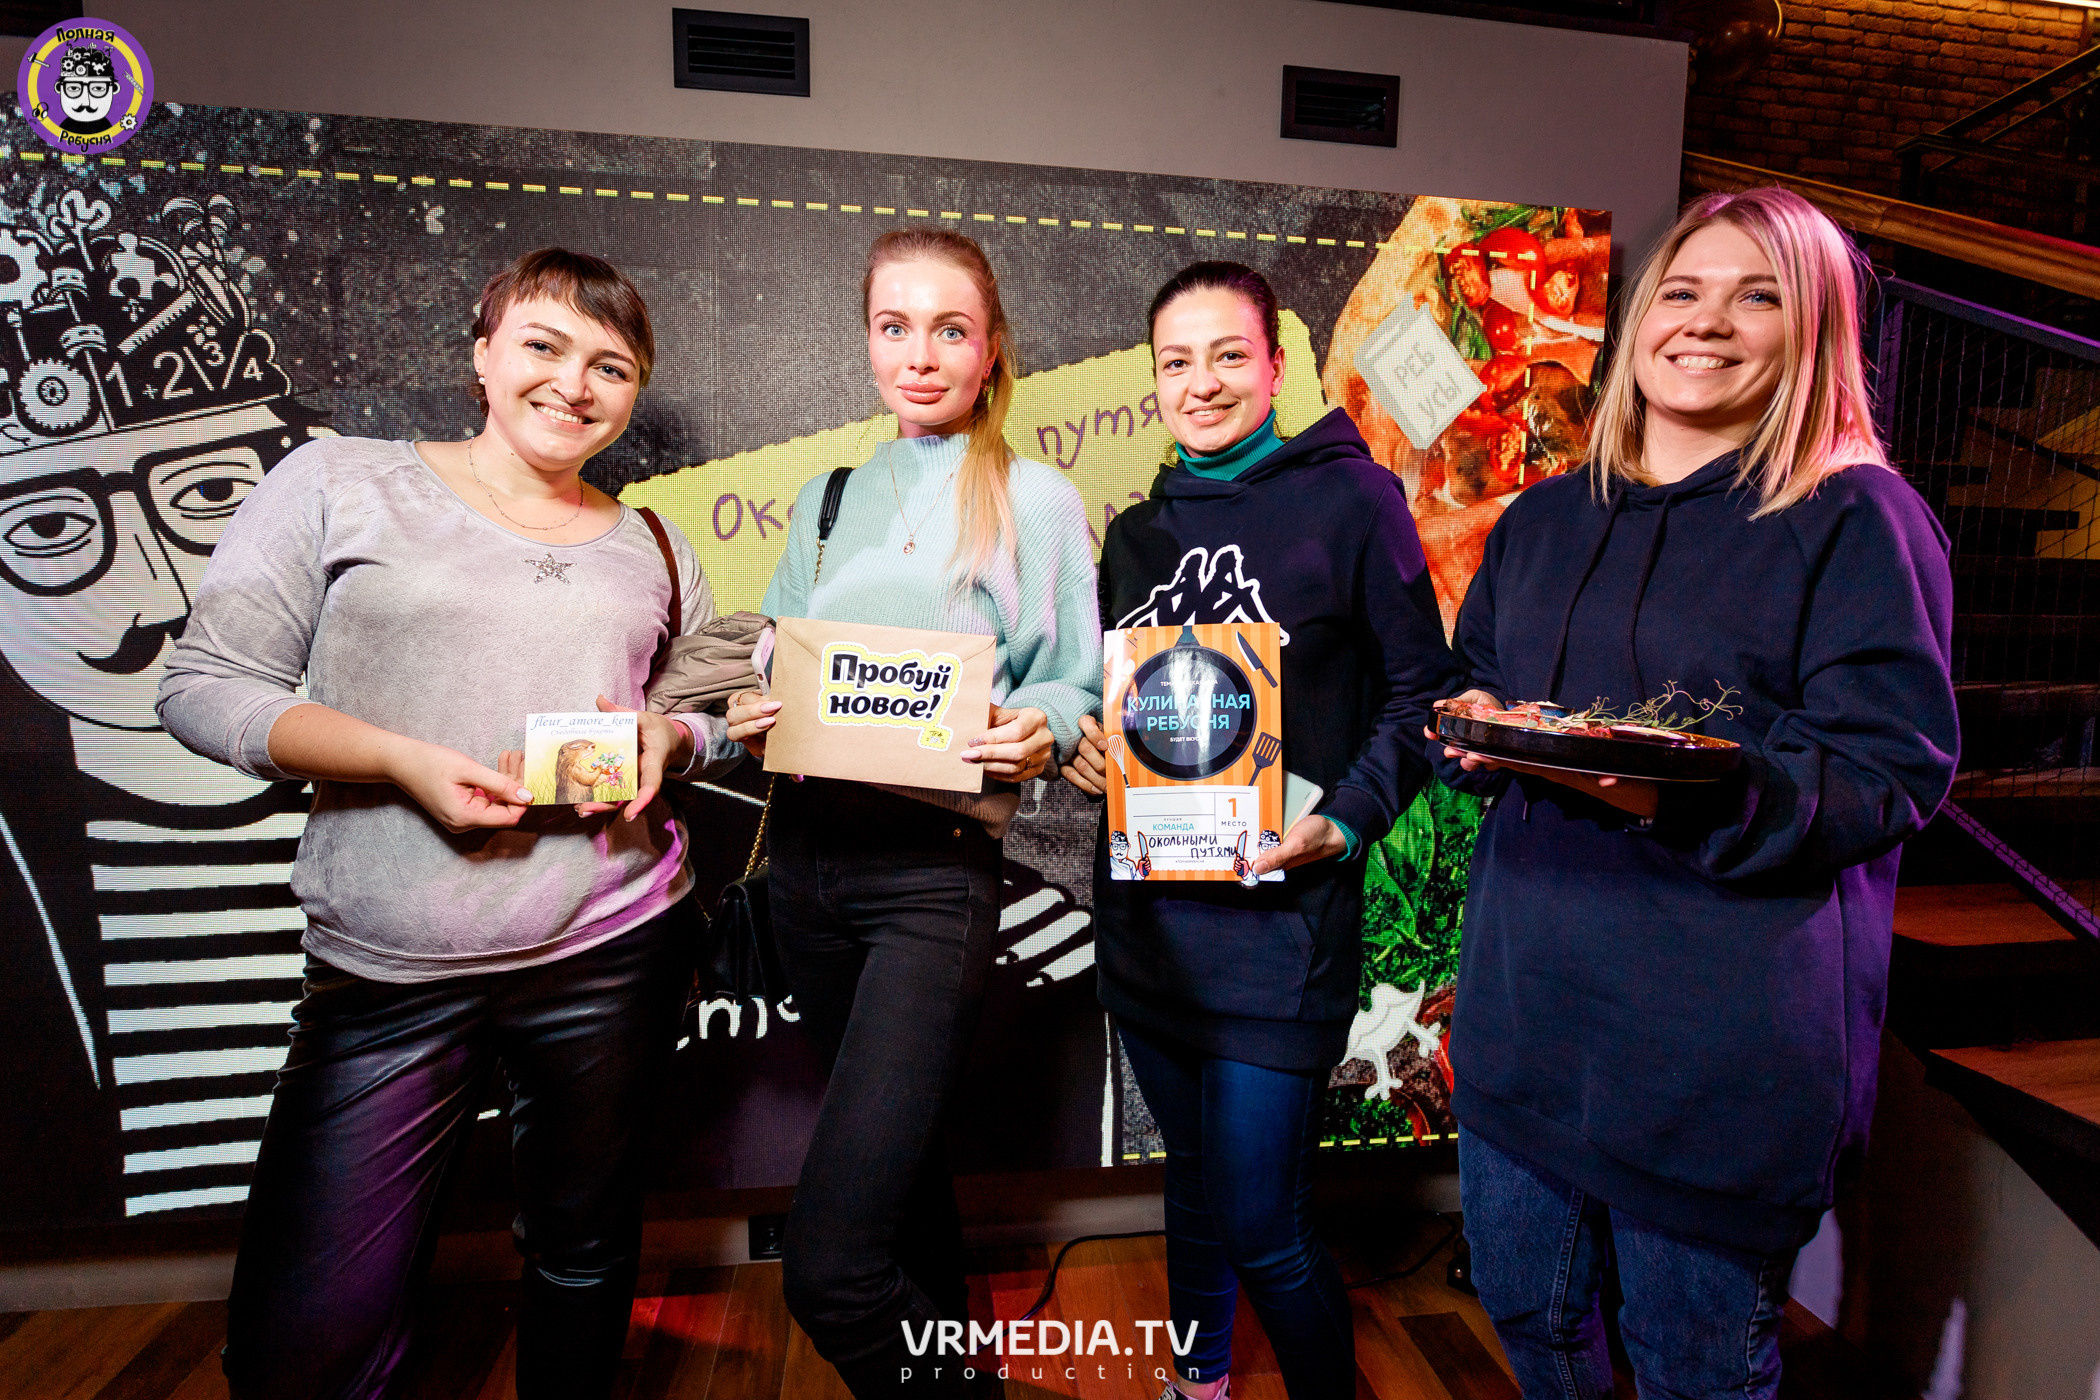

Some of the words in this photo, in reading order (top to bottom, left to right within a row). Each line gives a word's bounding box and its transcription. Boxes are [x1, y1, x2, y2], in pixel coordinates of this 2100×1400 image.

[1036, 391, 1163, 470] путя
[831, 653, 952, 691] Пробуй
[829, 694, 942, 719] новое!
[1127, 693, 1251, 713] КУЛИНАНАЯ
[1227, 797, 1237, 818] 1
[1152, 823, 1195, 832] КОМАНДА
[1221, 820, 1248, 828] МЕСТО
